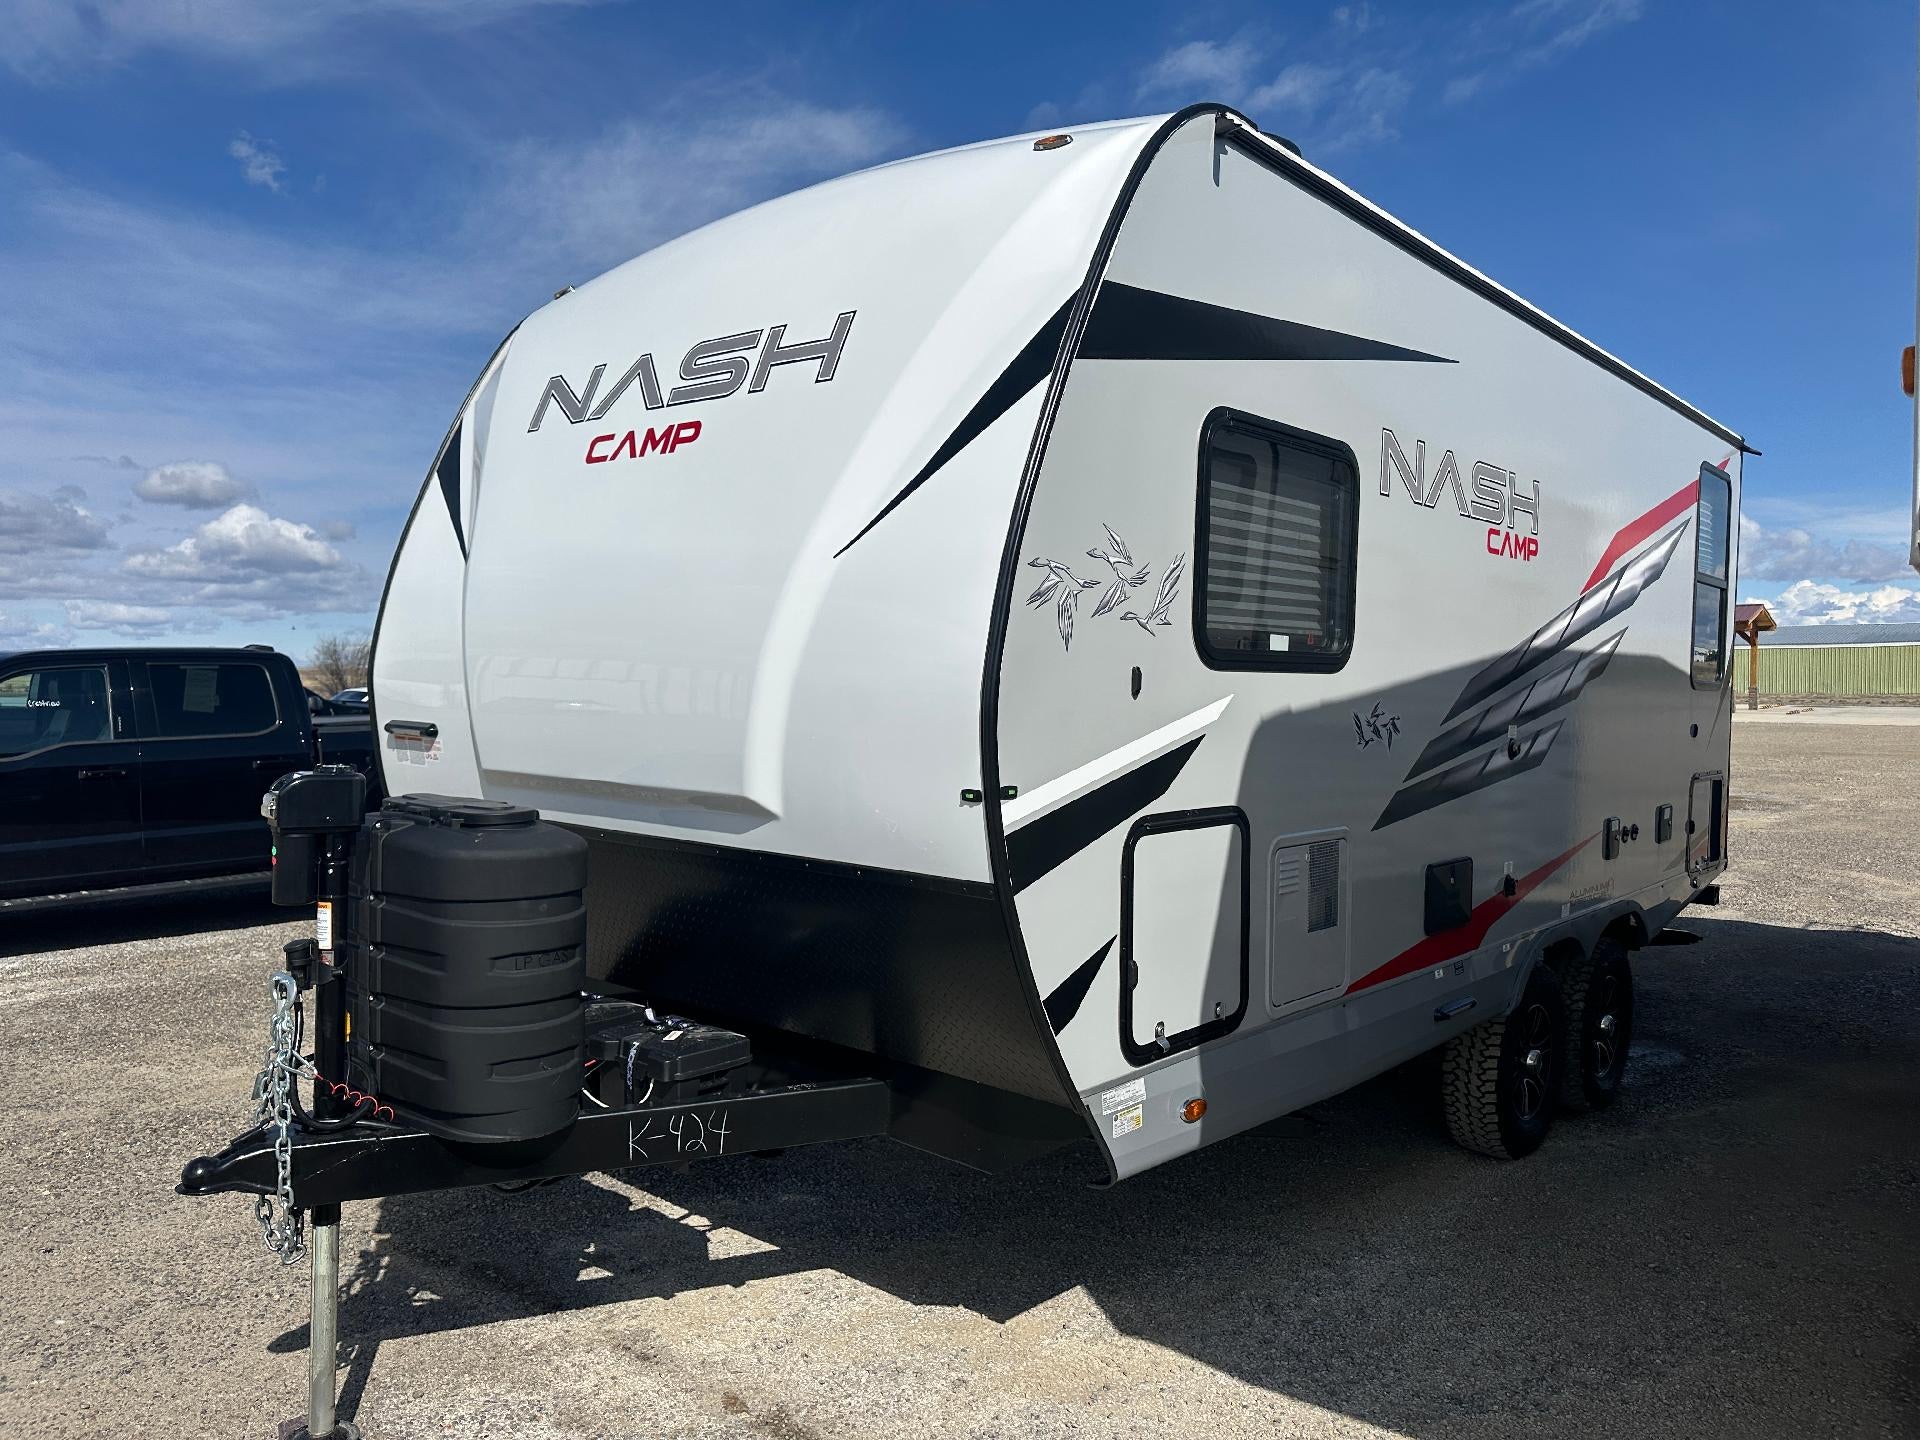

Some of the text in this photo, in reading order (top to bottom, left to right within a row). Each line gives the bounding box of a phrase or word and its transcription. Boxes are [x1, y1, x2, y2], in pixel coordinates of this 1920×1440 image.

[527, 310, 857, 433] NASH
[585, 420, 702, 464] CAMP
[1380, 427, 1540, 535] NASH
[1486, 527, 1539, 562] CAMP
[628, 1109, 732, 1160] K-424
